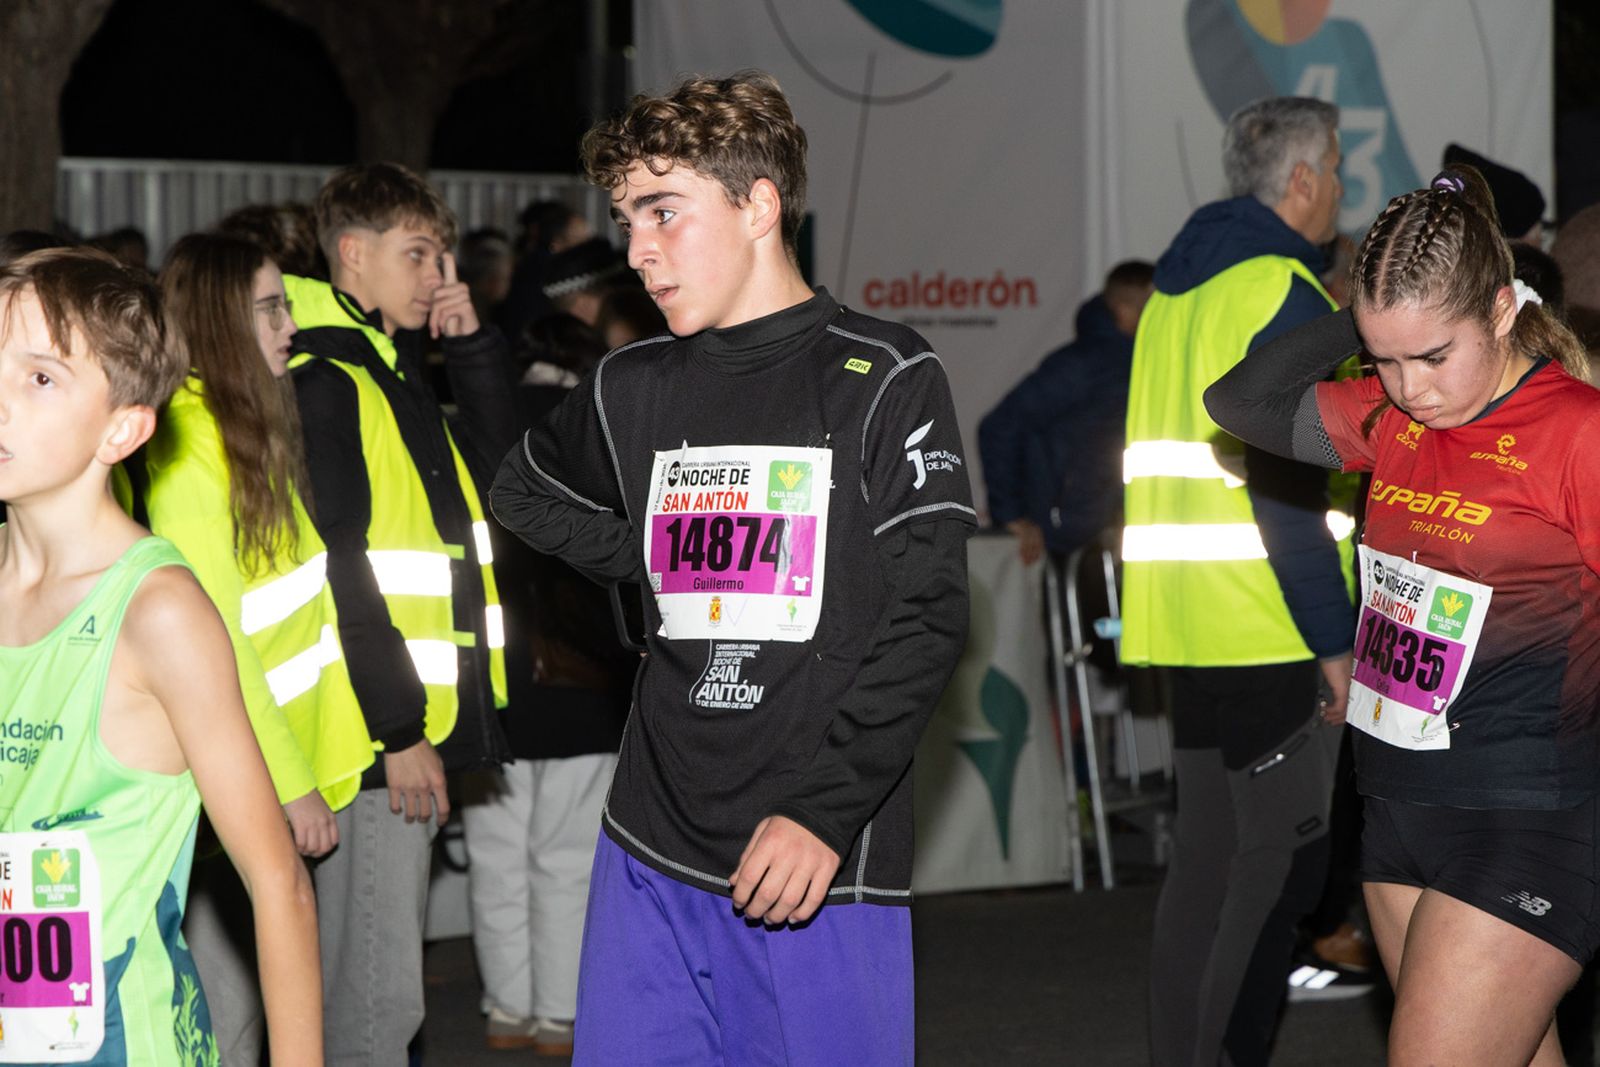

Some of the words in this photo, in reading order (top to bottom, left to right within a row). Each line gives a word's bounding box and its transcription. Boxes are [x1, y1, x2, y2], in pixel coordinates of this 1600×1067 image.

[863, 271, 1038, 309] calderón
[680, 468, 726, 487] NOCHE
[728, 468, 750, 485] DE
[662, 492, 691, 512] SAN
[693, 486, 749, 511] ANTÓN
[666, 516, 793, 573] 14874
[1408, 520, 1474, 544] TRIATLÓN
[693, 577, 744, 590] Guillermo
[1408, 584, 1424, 603] DE
[1360, 615, 1448, 692] 14335
[705, 665, 741, 683] SAN
[695, 679, 765, 704] ANTÓN
[0, 916, 73, 983] 00
